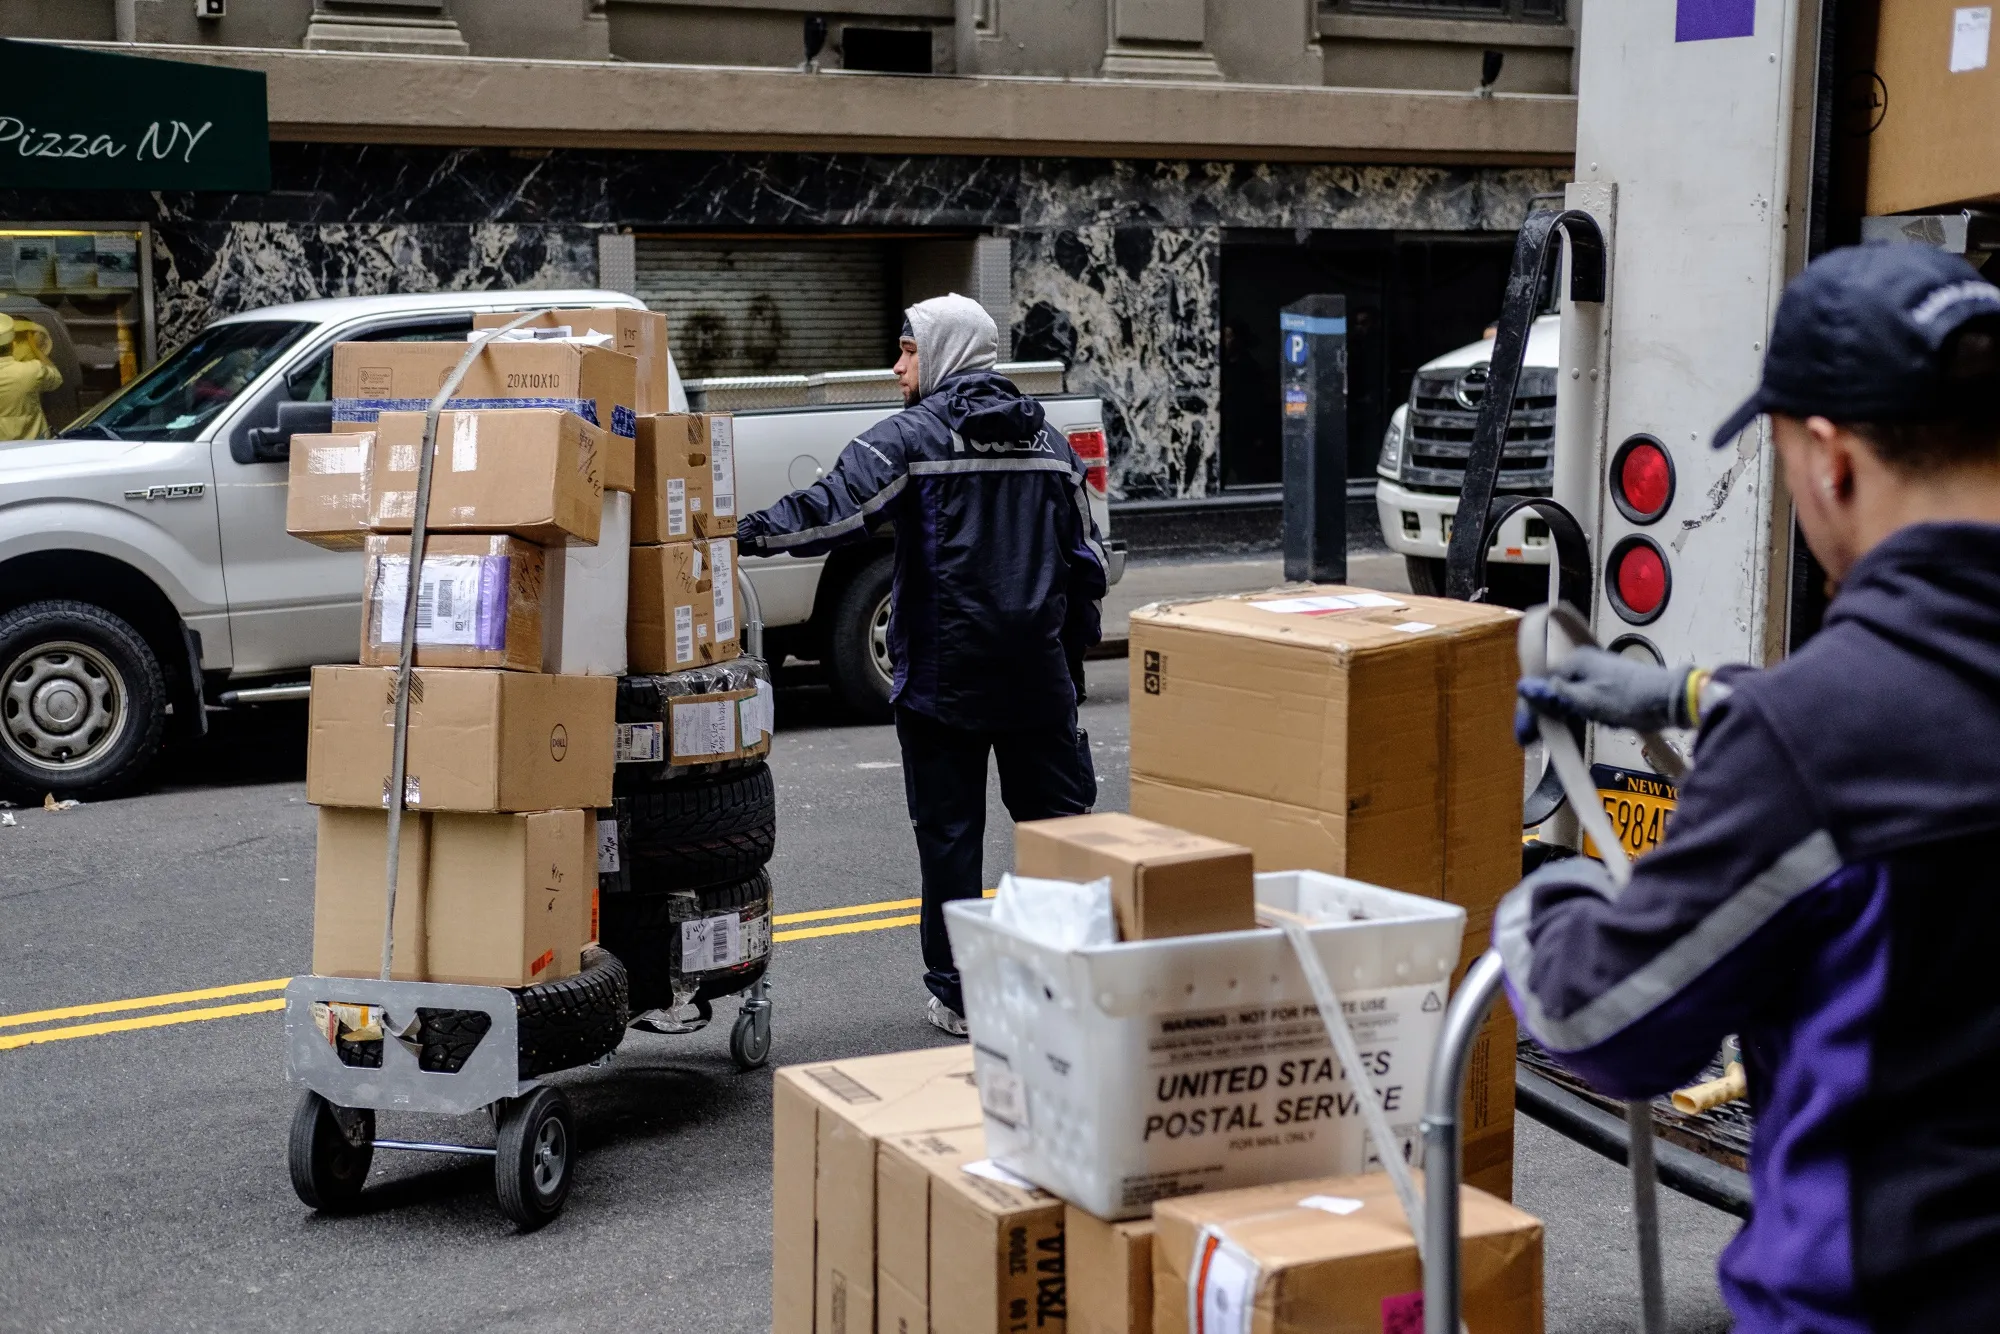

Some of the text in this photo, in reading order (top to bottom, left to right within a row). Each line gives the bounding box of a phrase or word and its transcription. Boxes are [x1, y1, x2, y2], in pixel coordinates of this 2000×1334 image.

[0, 117, 213, 163] Pizza NY
[1291, 334, 1304, 362] P
[507, 373, 560, 388] 20X10X10
[1627, 777, 1662, 796] NEW
[1161, 1013, 1227, 1033] WARNING
[1240, 1008, 1266, 1024] NOT
[1271, 1006, 1298, 1022] FOR
[1302, 1000, 1356, 1018] PRTE
[1157, 1050, 1393, 1102] UNITED STAES
[1143, 1086, 1404, 1142] POSTAL SERVE
